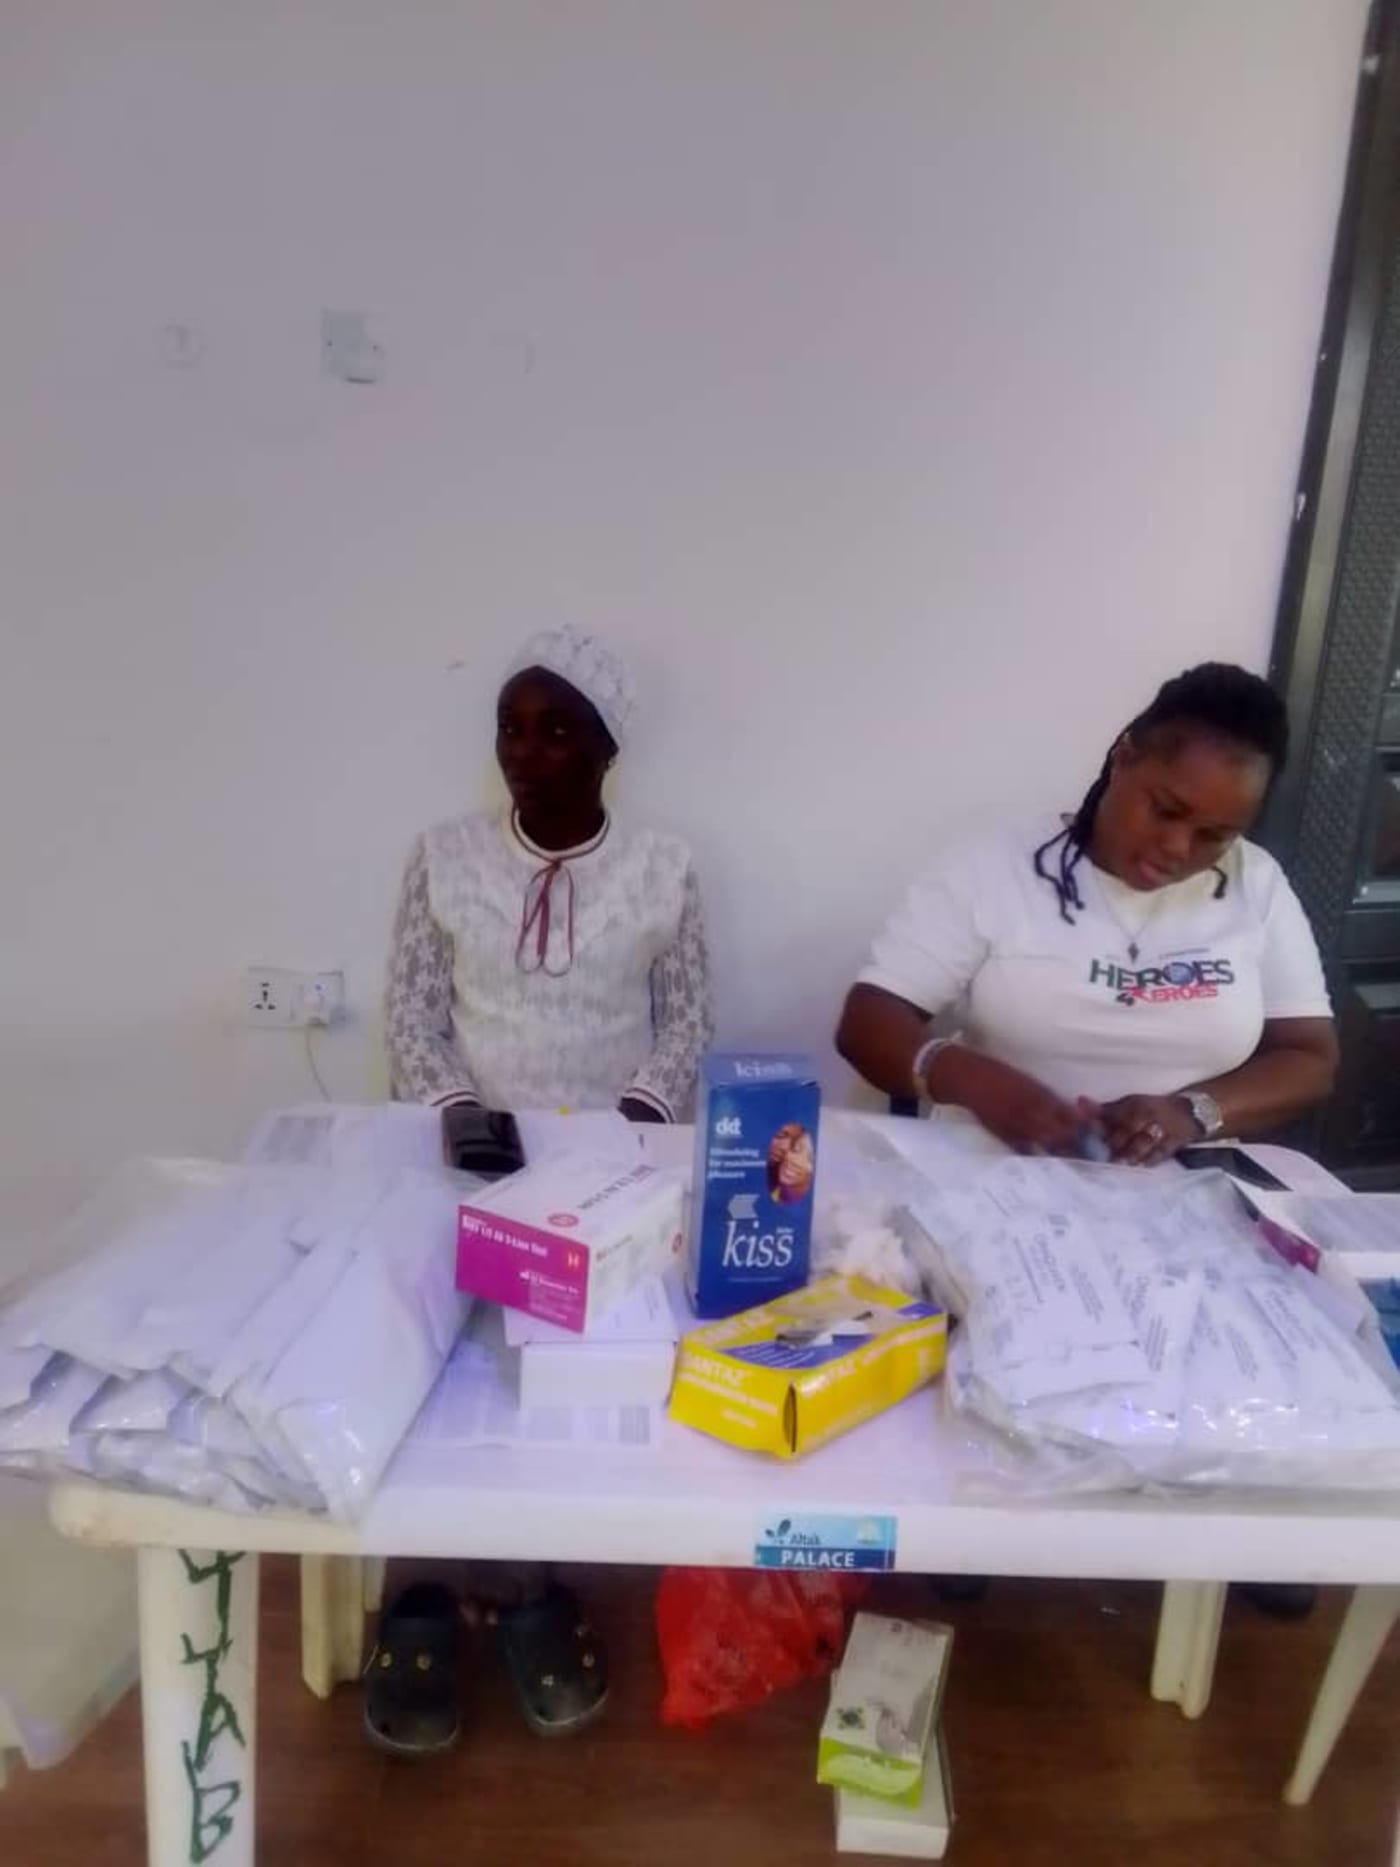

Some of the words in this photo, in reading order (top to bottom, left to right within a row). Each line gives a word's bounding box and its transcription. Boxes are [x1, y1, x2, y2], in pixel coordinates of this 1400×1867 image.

[1089, 958, 1235, 991] HEROES
[722, 1220, 794, 1268] kiss
[781, 1549, 857, 1568] PALACE
